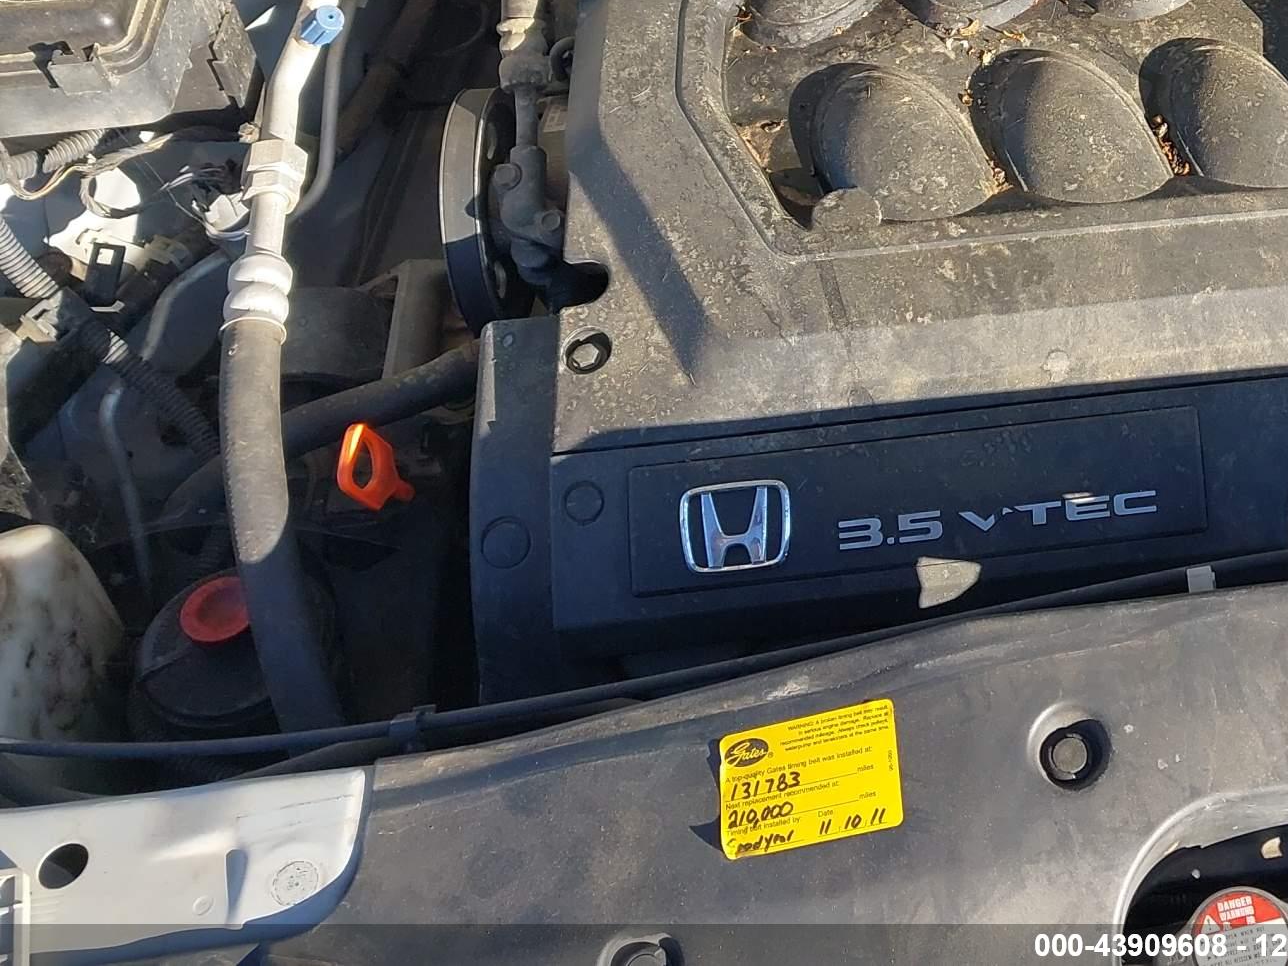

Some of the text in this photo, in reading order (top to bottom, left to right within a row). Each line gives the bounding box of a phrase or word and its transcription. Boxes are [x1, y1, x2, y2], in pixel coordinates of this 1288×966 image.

[837, 490, 1158, 551] 3.5 VTEC
[726, 742, 768, 767] Gates
[857, 764, 874, 772] miles
[731, 771, 801, 801] 131783
[741, 795, 782, 807] replacement
[783, 782, 831, 798] recommended
[858, 791, 877, 800] miles
[728, 801, 794, 830] 210,000
[763, 818, 791, 829] installed
[819, 808, 886, 835] 11 10 11
[1216, 895, 1253, 912] DANGER
